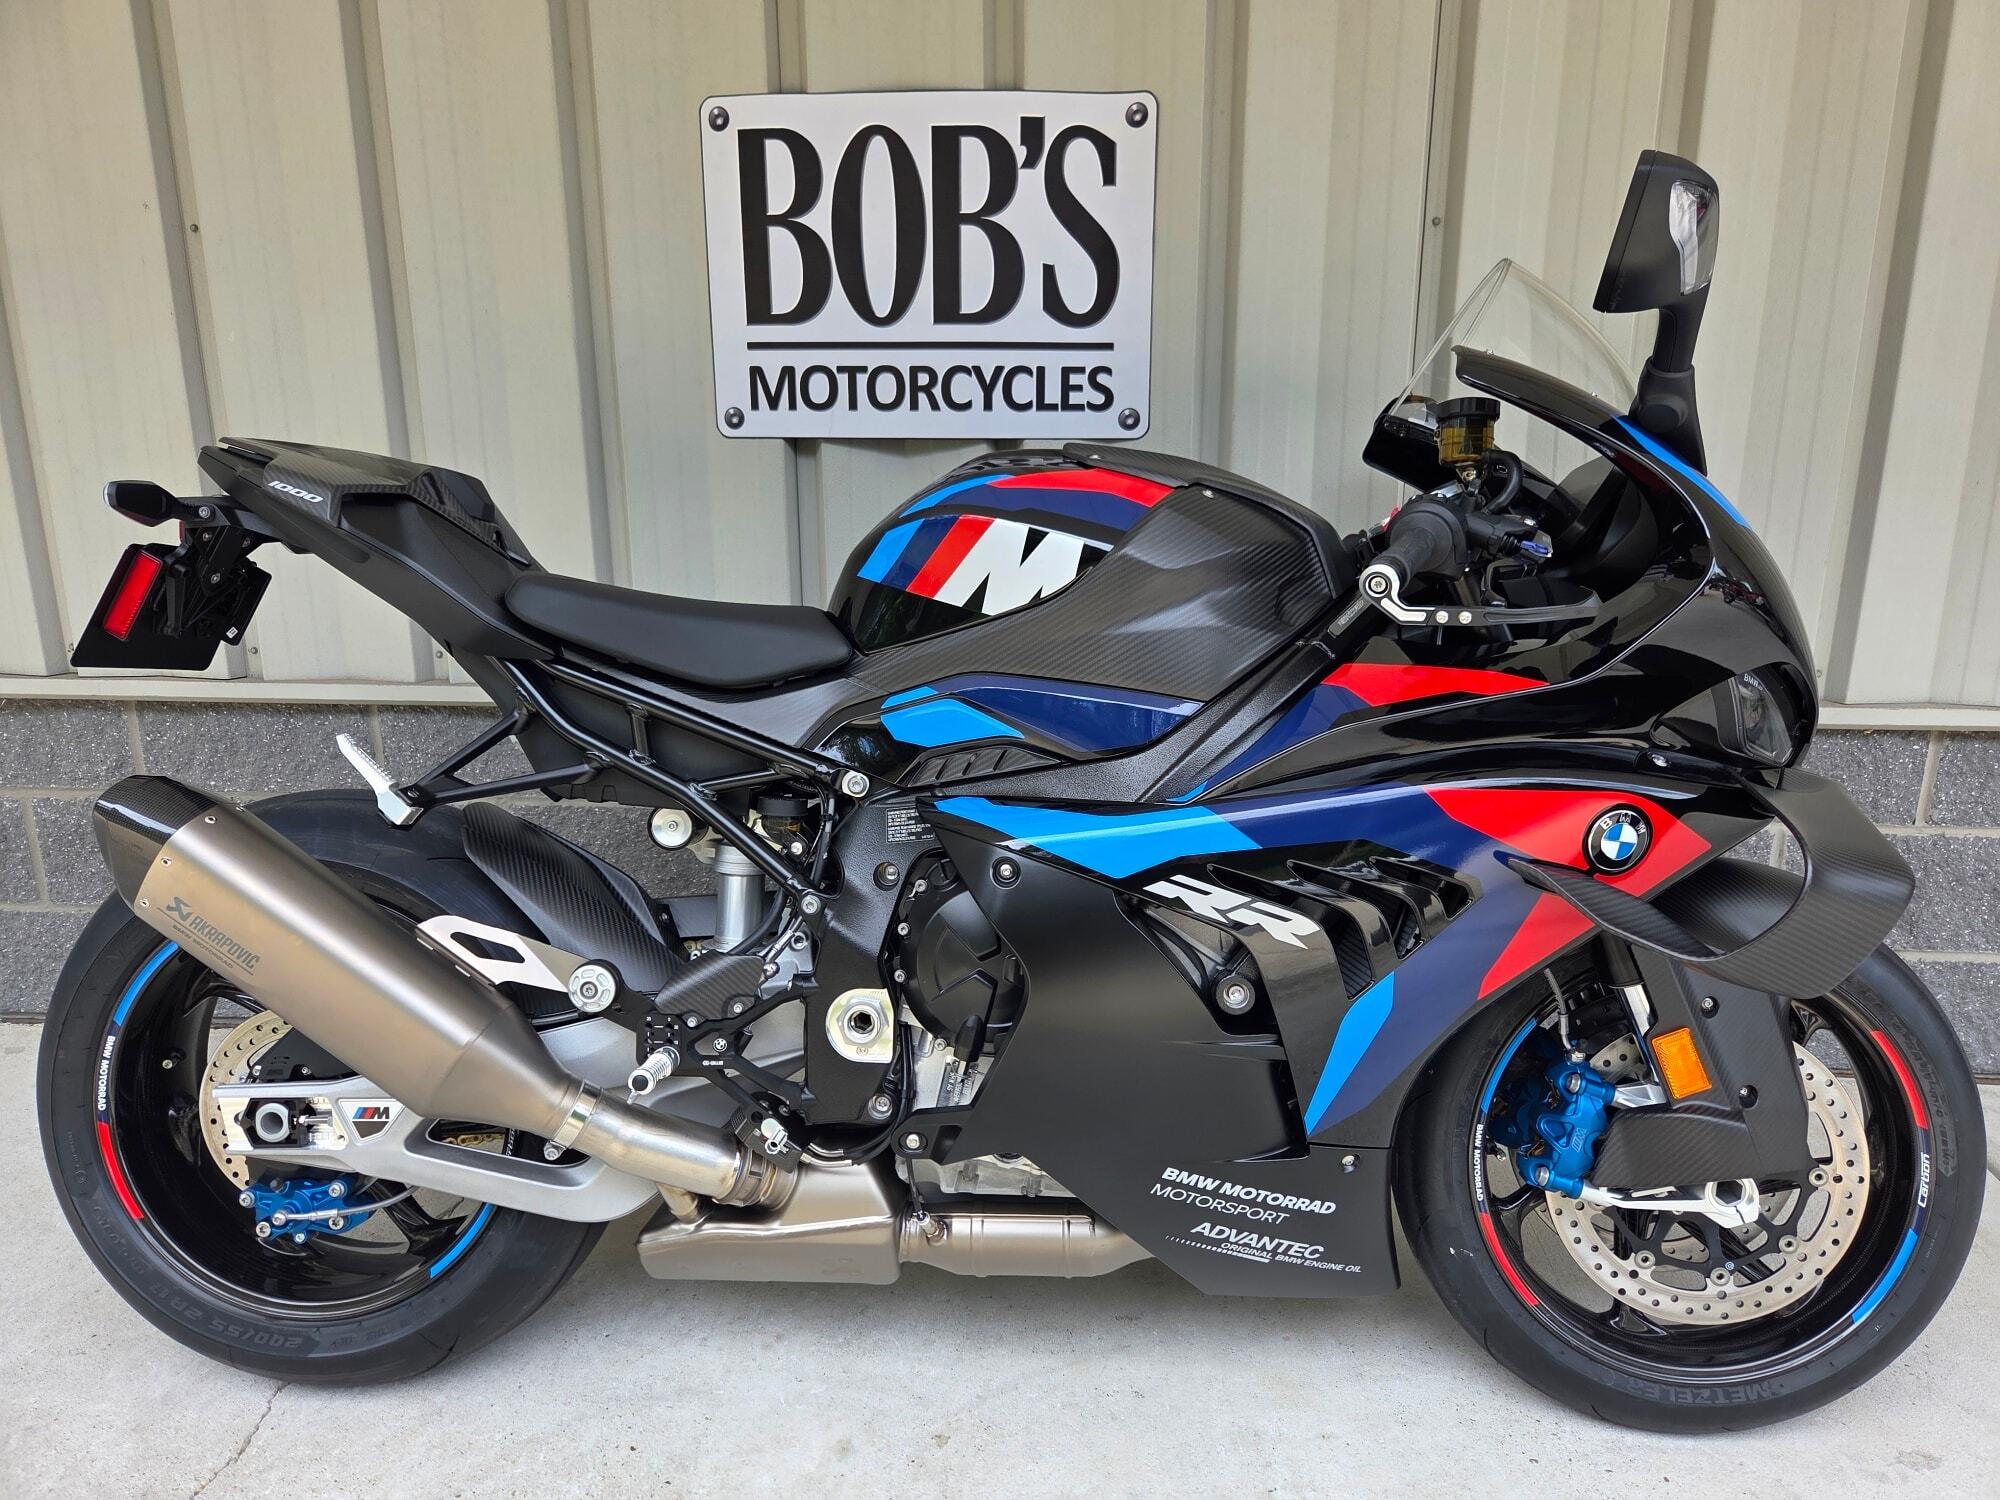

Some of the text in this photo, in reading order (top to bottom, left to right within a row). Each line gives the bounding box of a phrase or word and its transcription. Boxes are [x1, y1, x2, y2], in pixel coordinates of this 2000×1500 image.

[738, 116, 1120, 328] BOB'S
[749, 365, 1115, 412] MOTORCYCLES
[268, 480, 323, 502] 1000
[1143, 875, 1320, 949] RR
[97, 1035, 116, 1111] BMW MOTORRAD
[1473, 1124, 1484, 1201] BMW MOTORRAD
[1917, 1152, 1930, 1208] Carbon
[1150, 1184, 1290, 1225] MOTORSPORT
[1161, 1167, 1337, 1215] BMW MOTORRAD
[1190, 1222, 1324, 1259] ADVANTEC
[1221, 1242, 1363, 1273] ORIGINAL BMW ENGINE OIL
